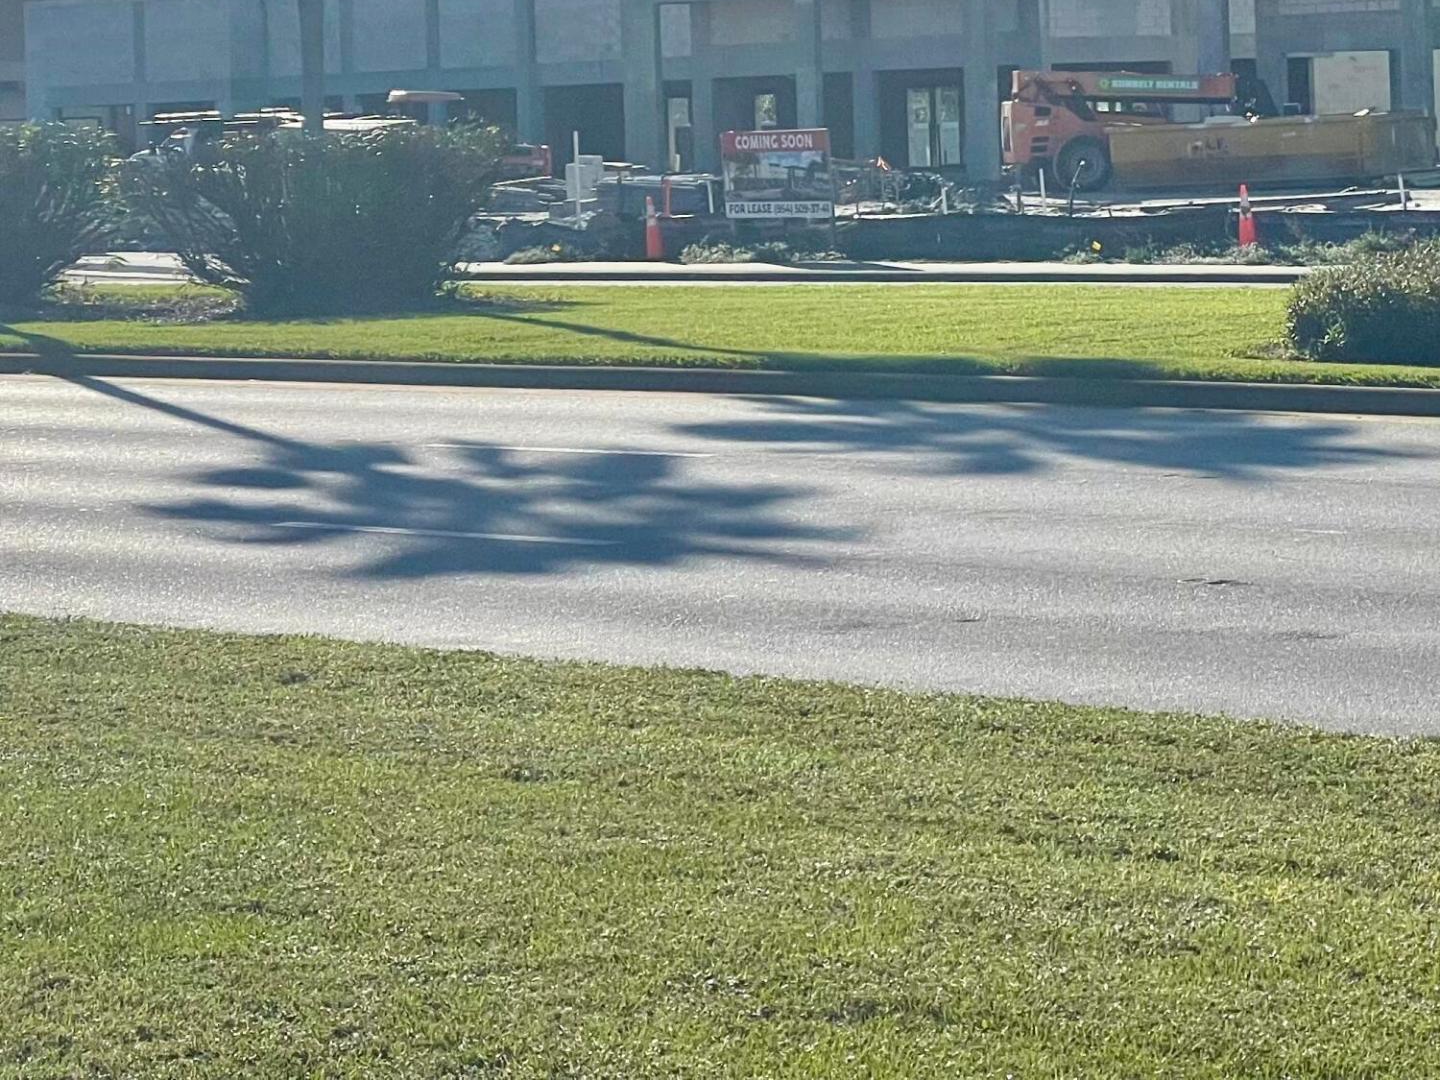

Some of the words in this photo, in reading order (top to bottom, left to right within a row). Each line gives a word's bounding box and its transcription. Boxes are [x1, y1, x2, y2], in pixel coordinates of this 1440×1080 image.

[735, 135, 778, 150] COMING
[781, 133, 813, 148] SOON
[729, 203, 745, 214] FOR
[747, 203, 772, 213] LEASE
